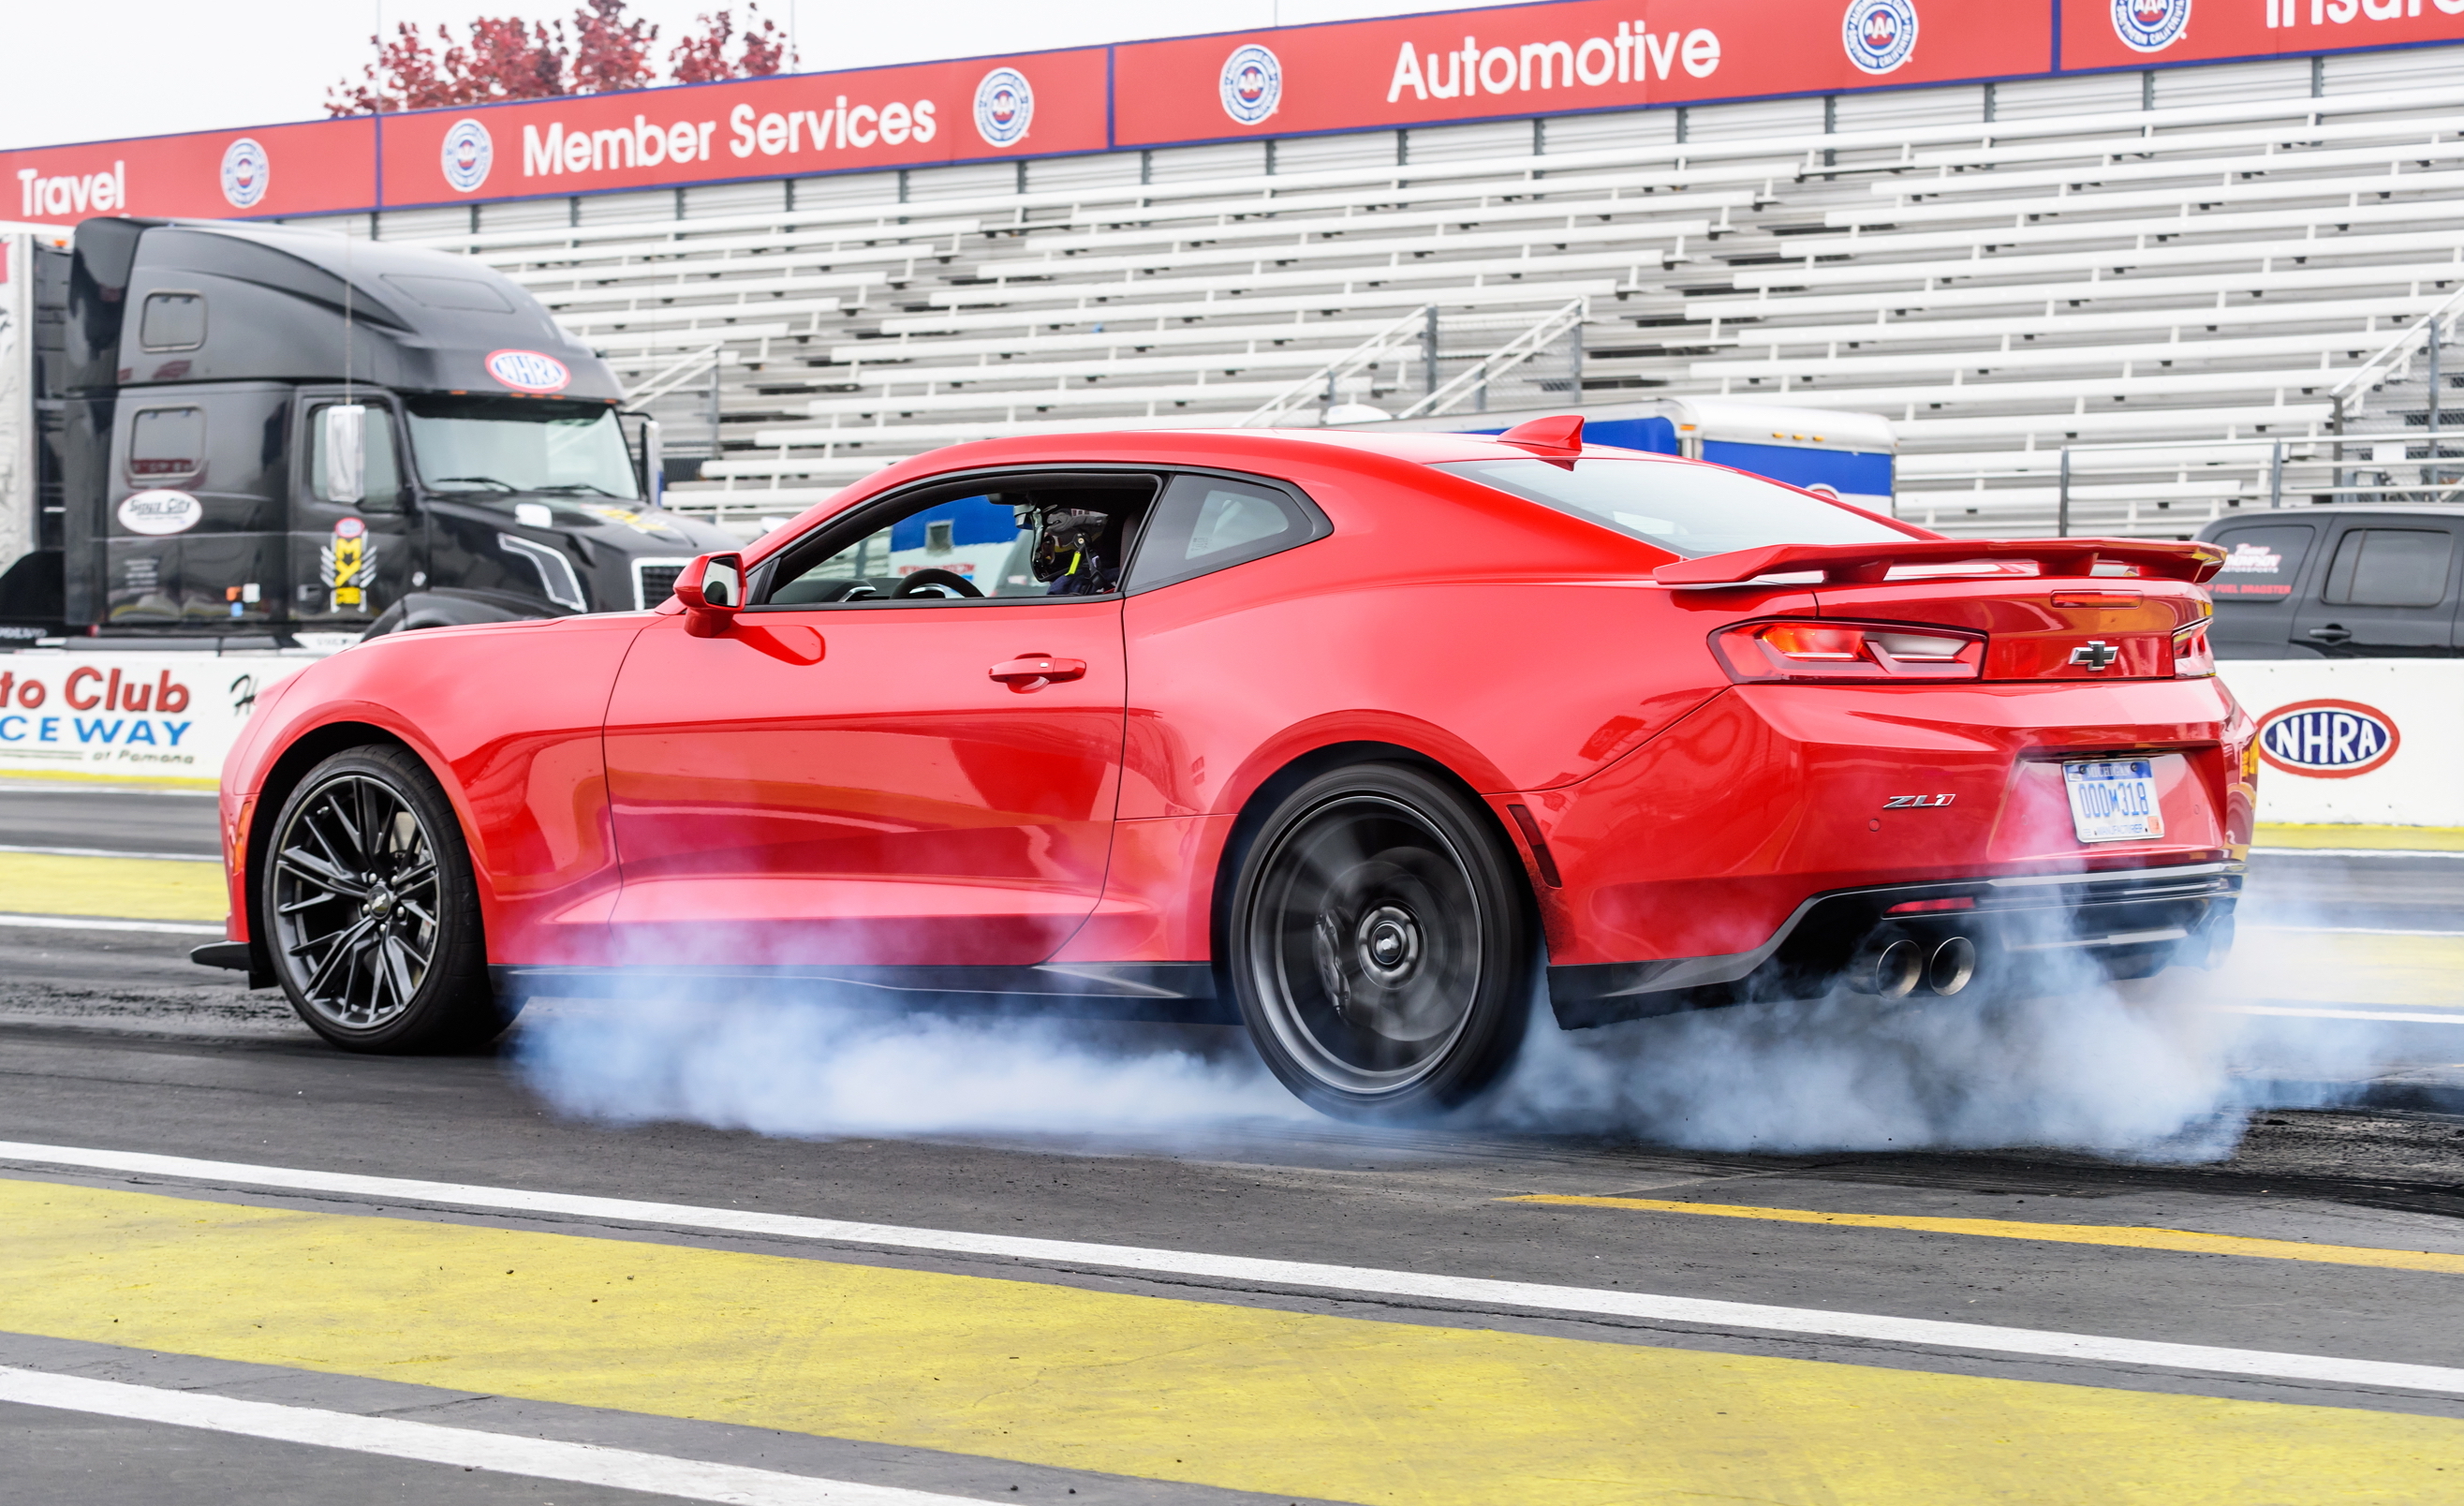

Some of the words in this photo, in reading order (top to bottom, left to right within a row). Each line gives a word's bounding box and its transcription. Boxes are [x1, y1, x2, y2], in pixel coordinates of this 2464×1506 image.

[2134, 0, 2167, 14] AAA
[1864, 17, 1895, 39] AAA
[1386, 20, 1721, 103] Automotive
[523, 114, 716, 177] Member
[729, 96, 937, 158] Services
[17, 159, 125, 217] Travel
[495, 356, 564, 385] NHRA
[2224, 554, 2281, 568] HOMPSON
[2215, 584, 2238, 594] FUEL
[2240, 584, 2293, 595] DRAGSTER
[65, 666, 190, 714] Club
[0, 716, 193, 746] CEWAY
[2276, 713, 2378, 764] NHRA
[2087, 765, 2131, 778] MICHIGAN
[1882, 793, 1956, 809] ZL1
